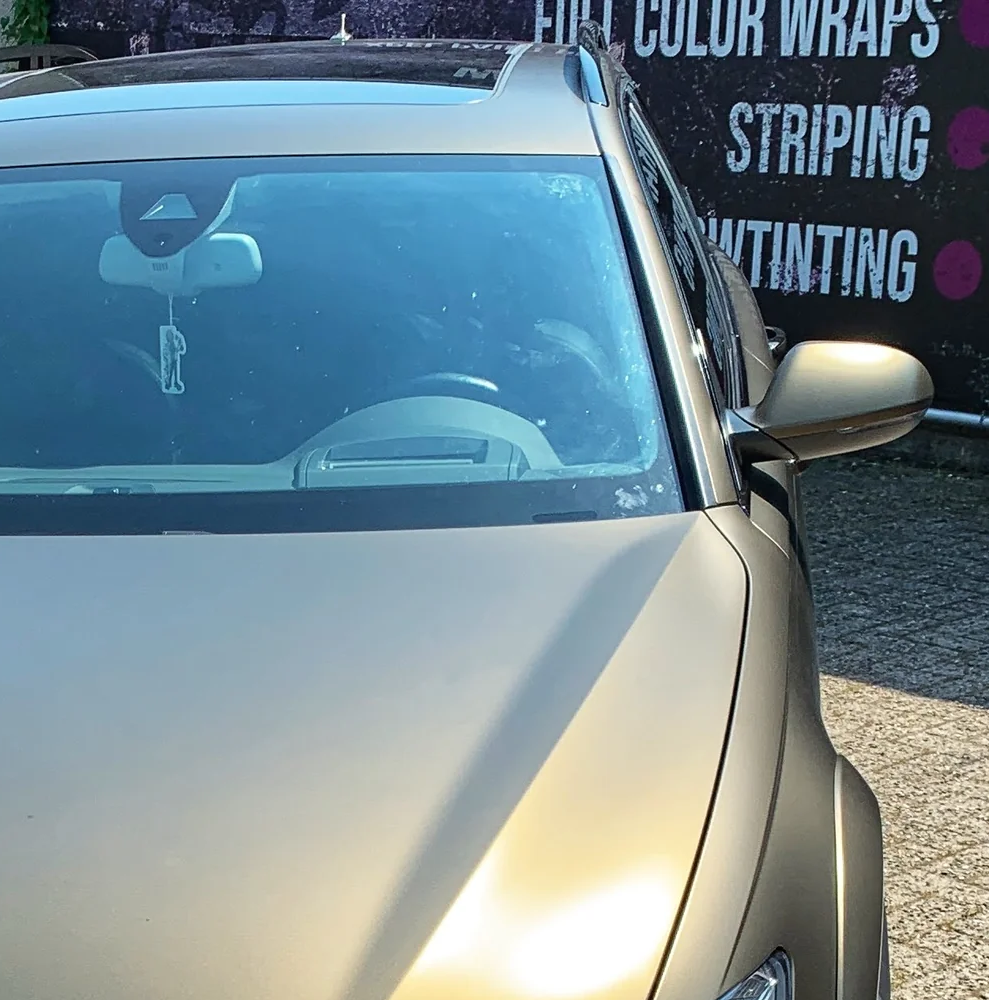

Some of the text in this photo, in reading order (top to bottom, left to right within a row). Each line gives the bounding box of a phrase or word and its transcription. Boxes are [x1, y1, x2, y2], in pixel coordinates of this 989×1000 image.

[534, 0, 941, 58] FUL COLOR WRAPS
[726, 101, 931, 181] STRIPING
[698, 217, 919, 302] WTINTING
